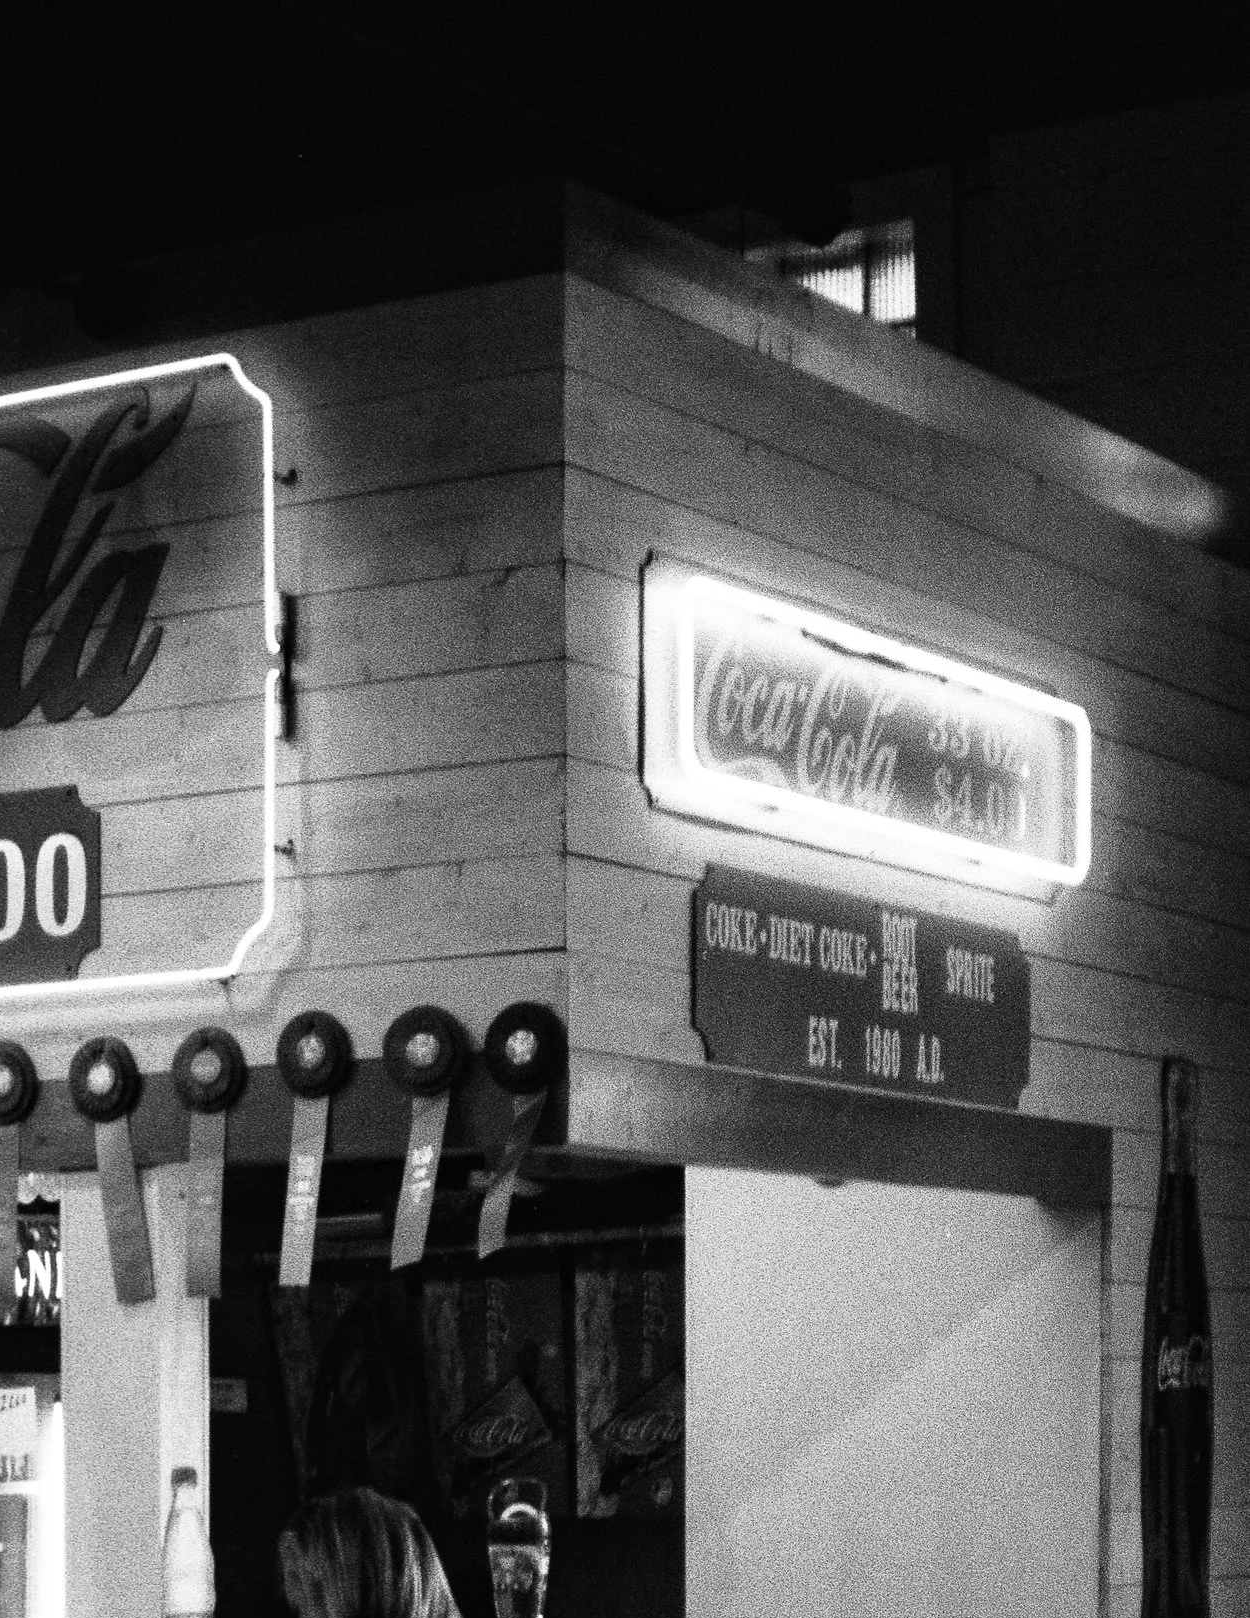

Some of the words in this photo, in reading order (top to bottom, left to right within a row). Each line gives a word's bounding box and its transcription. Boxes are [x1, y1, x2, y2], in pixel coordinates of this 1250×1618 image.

[705, 902, 759, 956] COKE
[768, 915, 815, 968] DIET
[819, 925, 868, 978] COKE
[946, 946, 995, 1003] SPRITE
[808, 1014, 843, 1069] EST.
